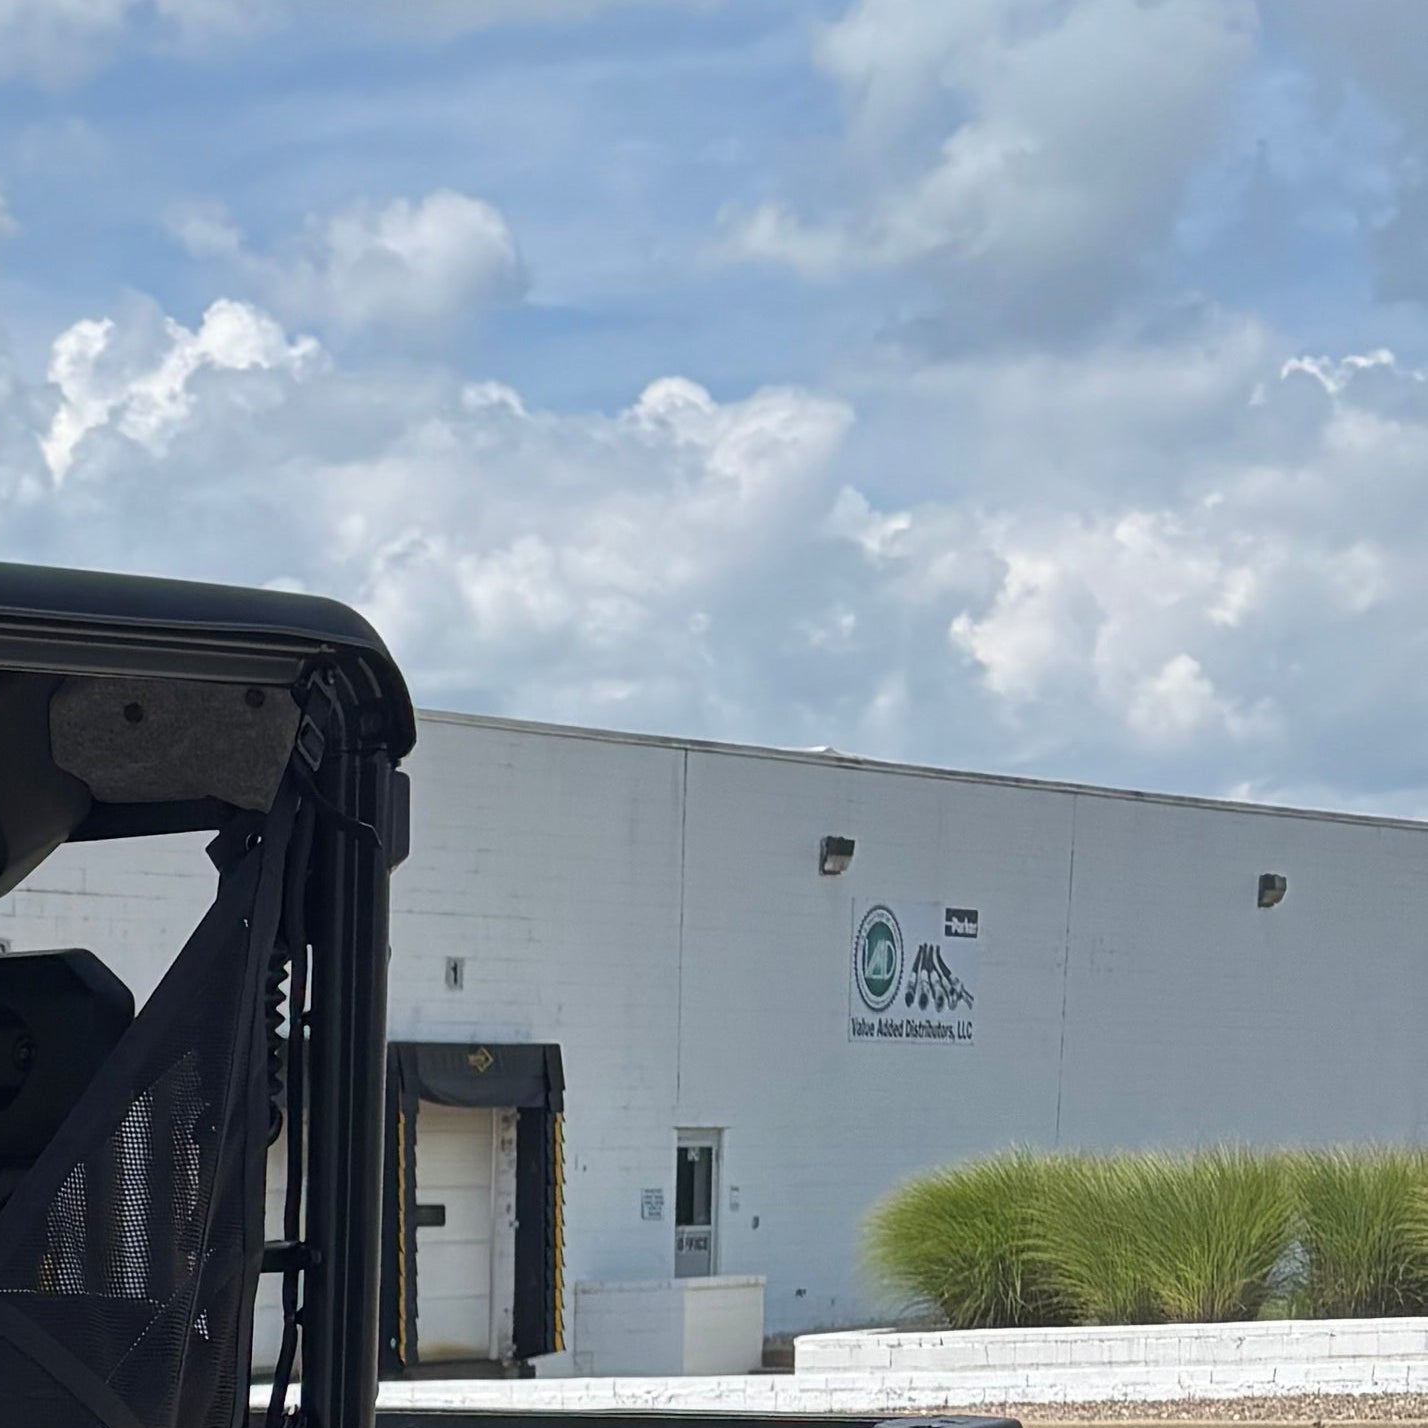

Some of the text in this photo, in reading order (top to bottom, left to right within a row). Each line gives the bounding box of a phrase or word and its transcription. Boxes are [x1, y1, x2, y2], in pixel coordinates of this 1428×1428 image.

[851, 1017, 875, 1038] Value
[877, 1018, 904, 1038] Added
[957, 1020, 973, 1040] LLC
